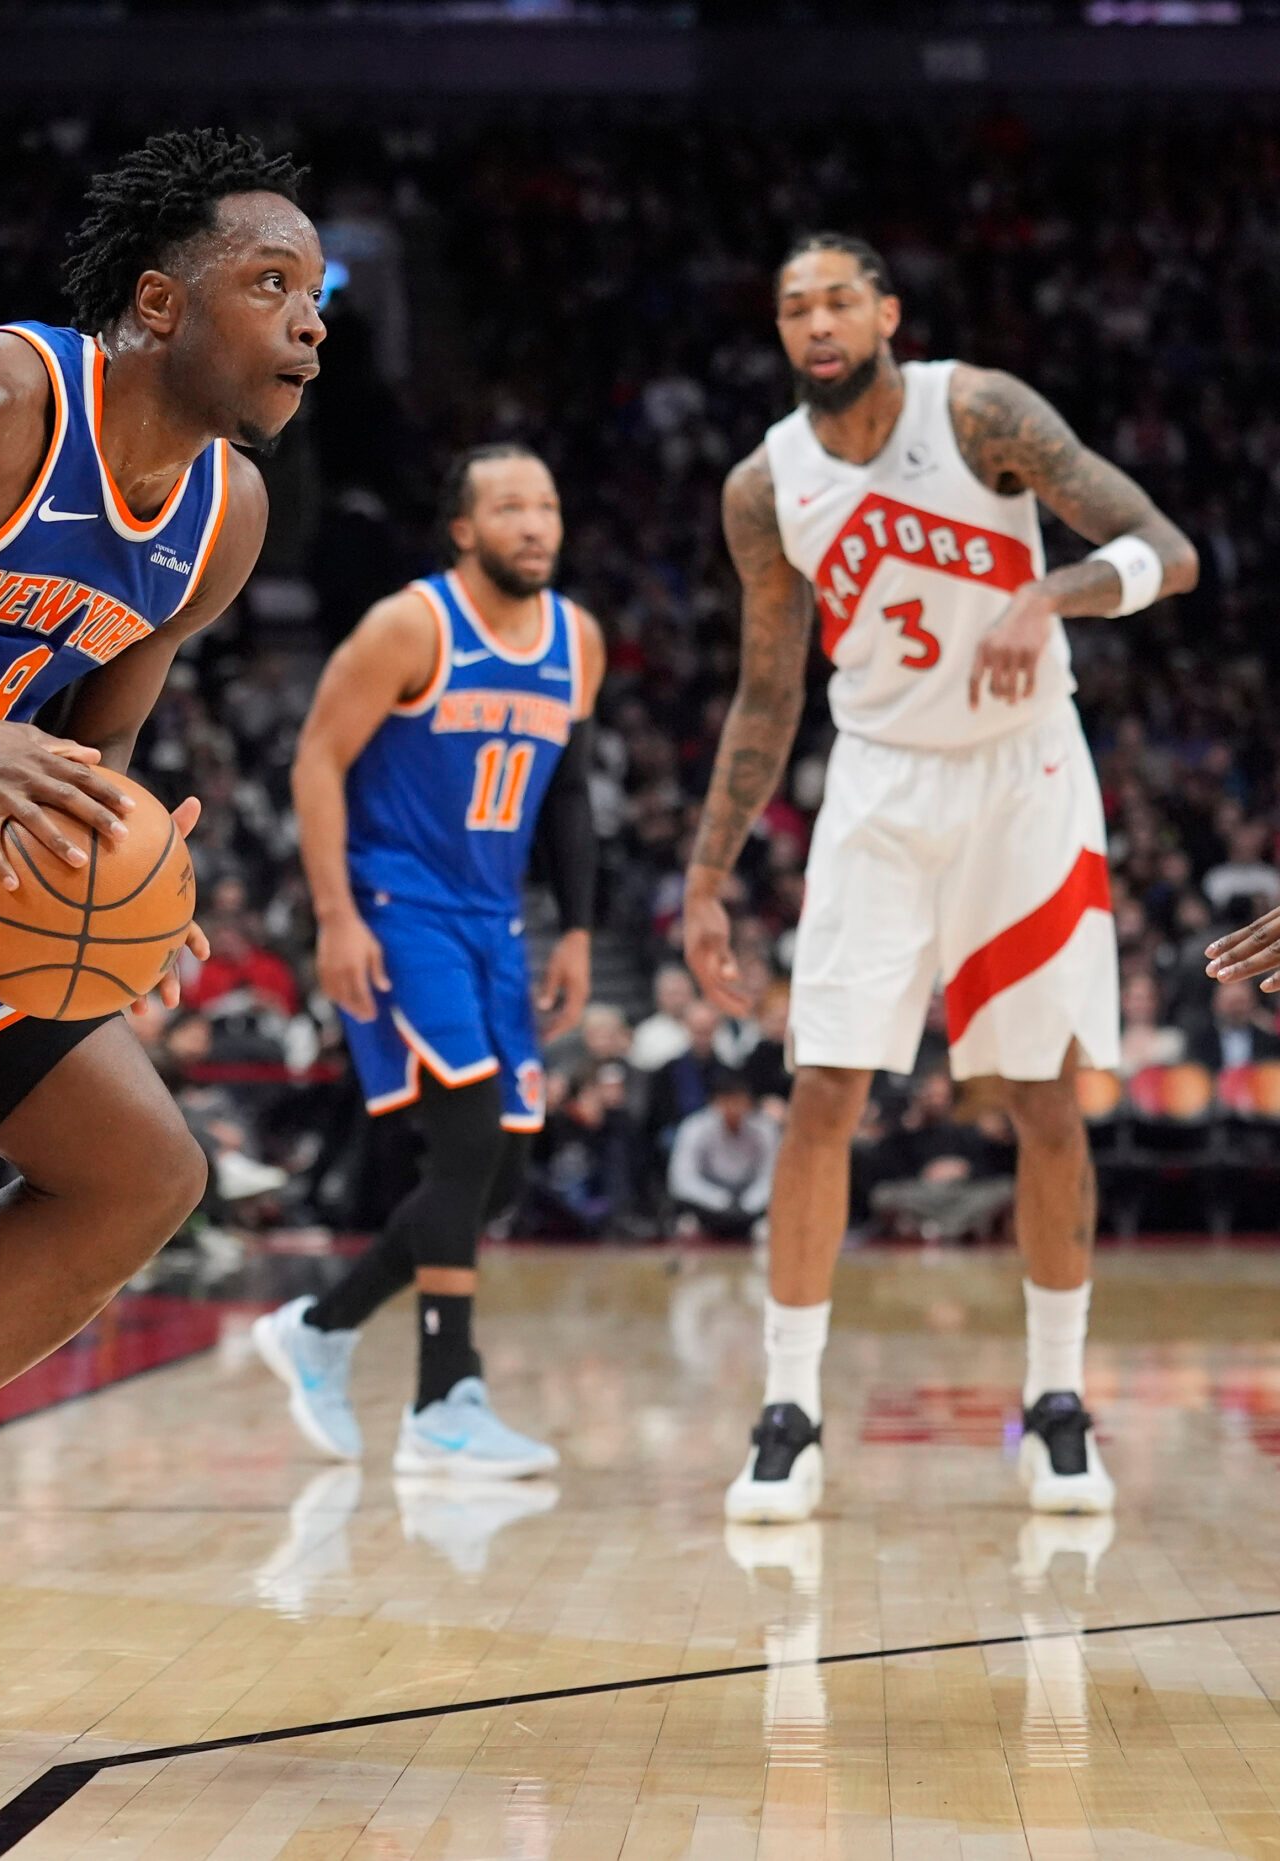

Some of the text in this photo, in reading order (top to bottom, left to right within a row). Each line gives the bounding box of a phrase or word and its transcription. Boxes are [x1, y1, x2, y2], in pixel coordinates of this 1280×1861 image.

[150, 551, 193, 575] abu dhabi
[63, 591, 156, 665] YORK
[881, 598, 942, 672] 3
[465, 738, 536, 832] 11
